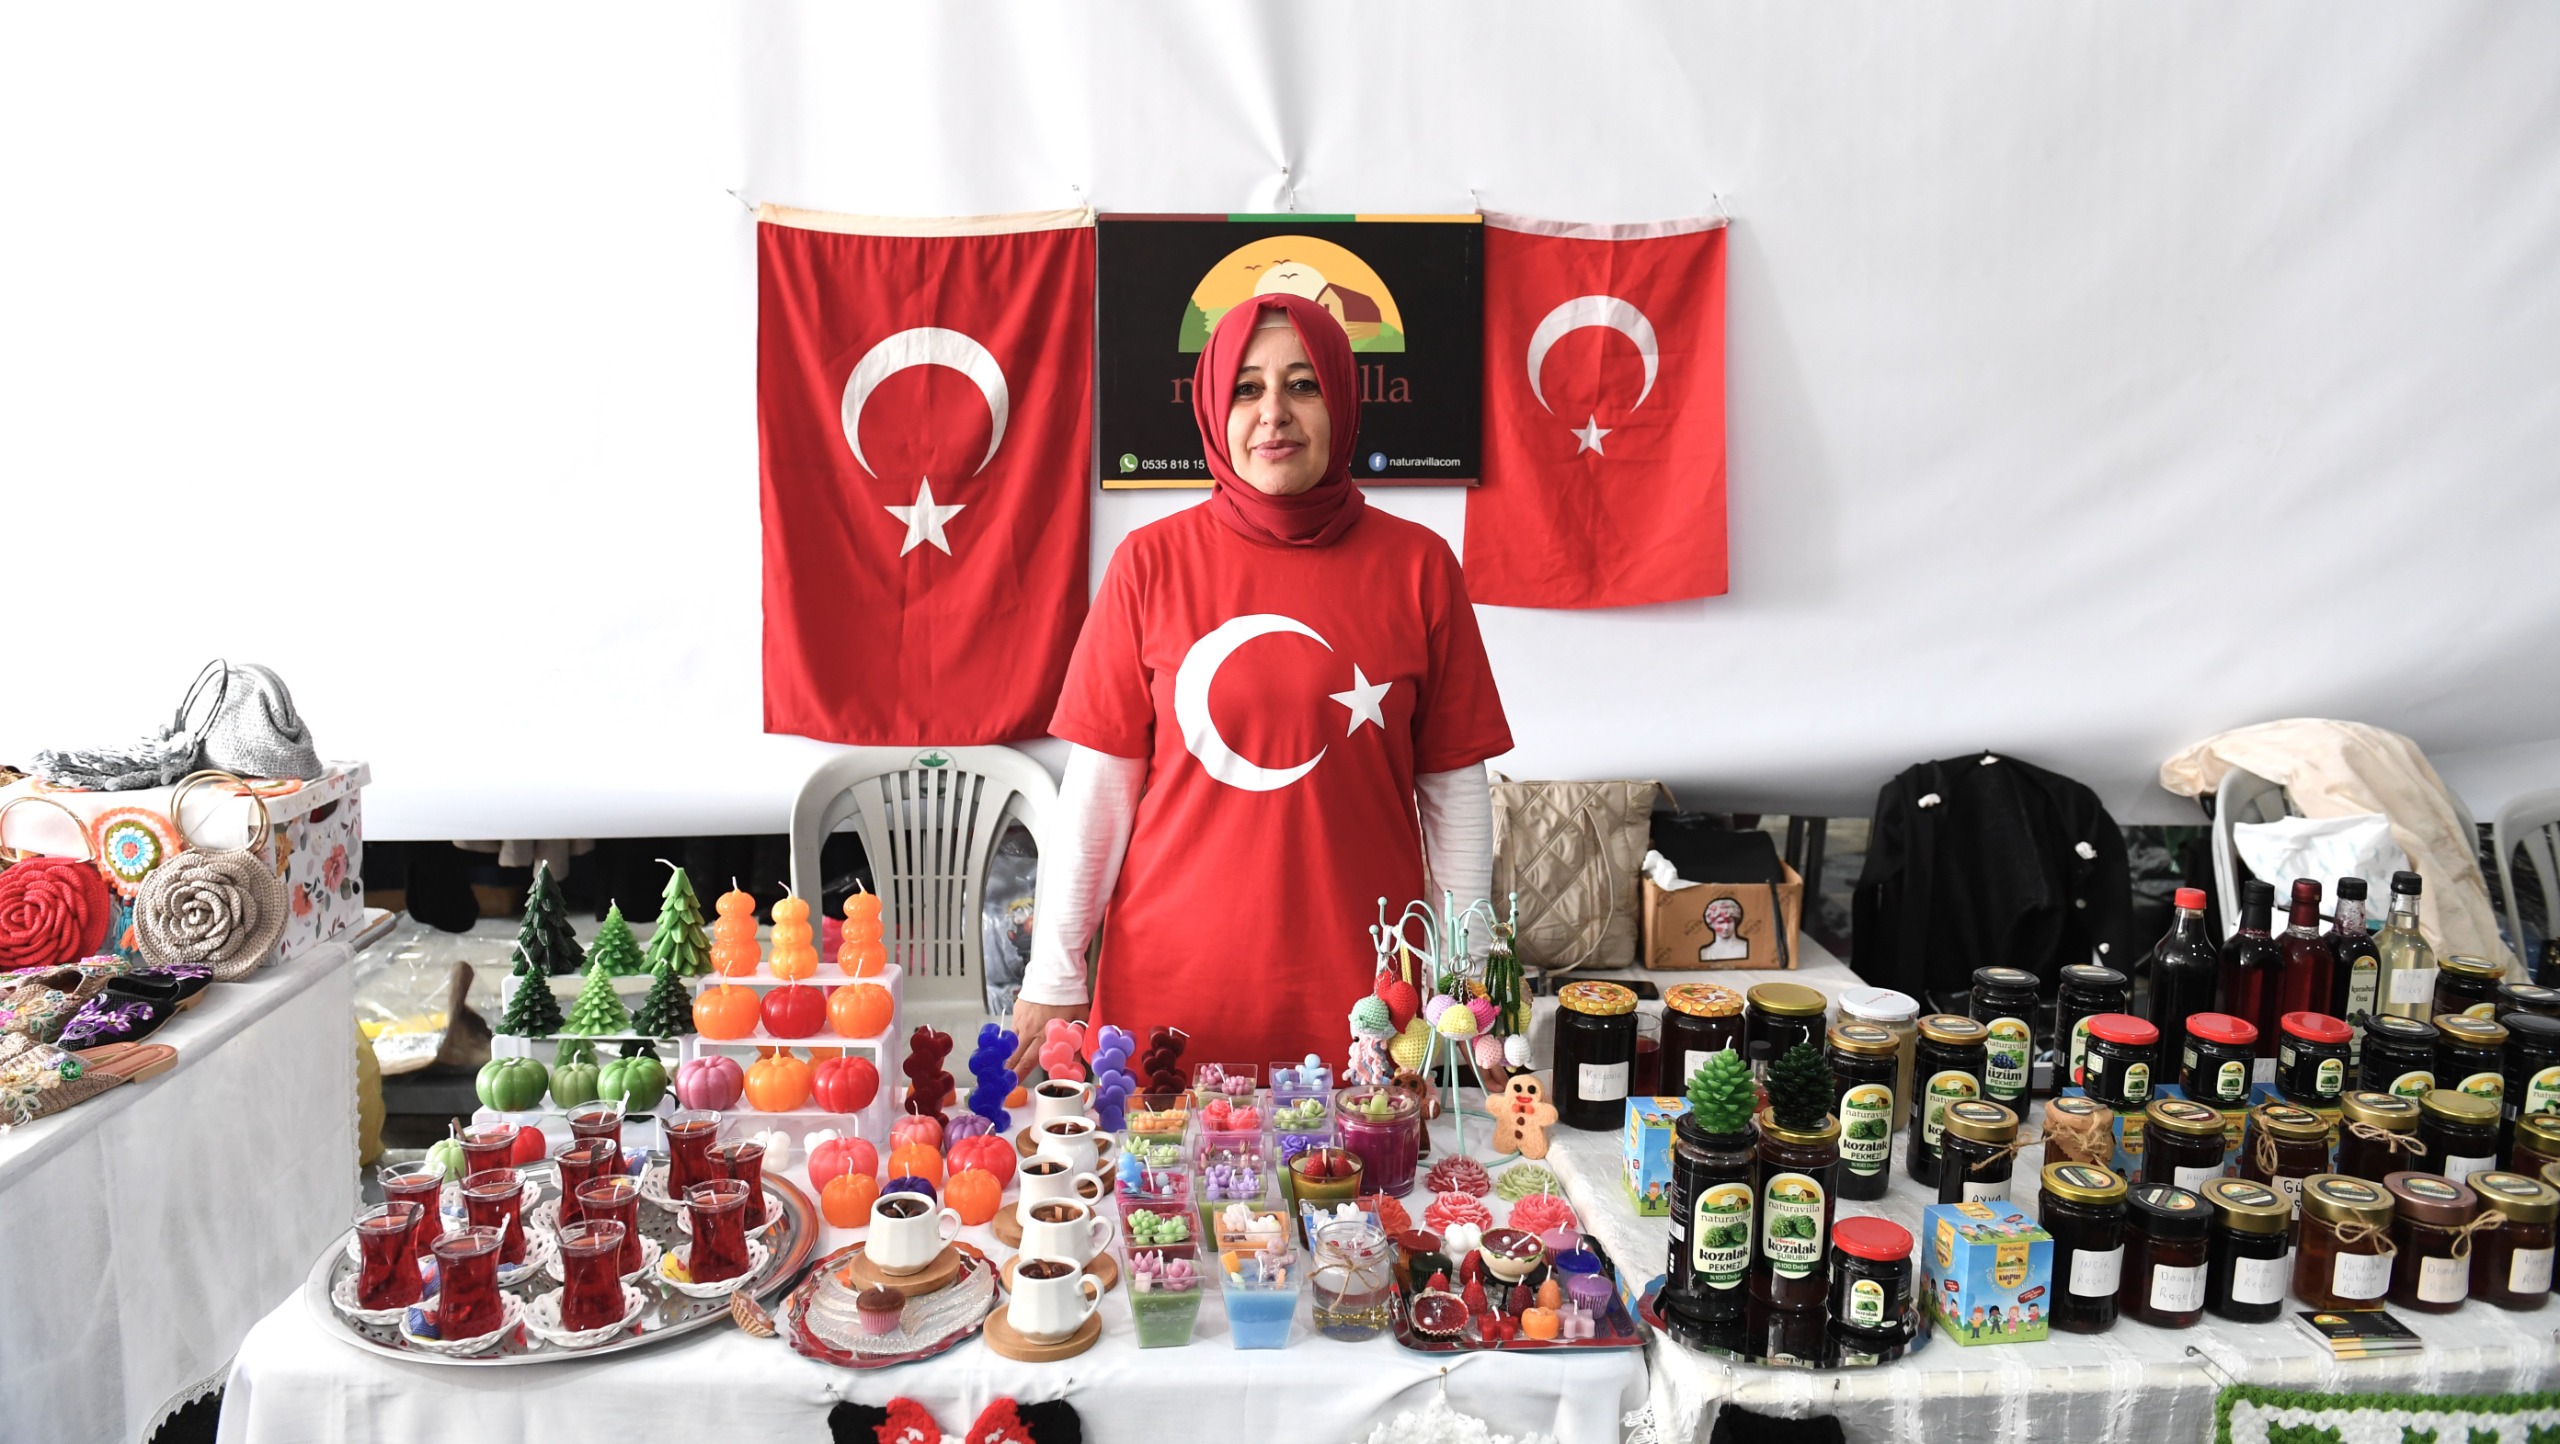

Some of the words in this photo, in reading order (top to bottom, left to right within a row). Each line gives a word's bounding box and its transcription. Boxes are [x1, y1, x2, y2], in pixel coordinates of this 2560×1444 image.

[1141, 459, 1168, 470] 0535
[1170, 459, 1190, 470] 818
[1193, 459, 1205, 469] 15
[1389, 457, 1461, 467] naturavillacom
[1986, 1040, 2028, 1051] naturavilla
[1987, 1066, 2022, 1081] üzüm
[1845, 1108, 1891, 1119] naturavilla
[1843, 1138, 1888, 1152] kozalak
[1850, 1151, 1882, 1161] PEKMEZİ
[1768, 1201, 1820, 1214] naturavilla
[1700, 1210, 1751, 1224] naturavilla
[1767, 1237, 1817, 1254] kozalak
[1699, 1246, 1748, 1262] kozalak
[1776, 1252, 1809, 1261] ŞURUBU
[1708, 1260, 1743, 1272] PEKMEZİ
